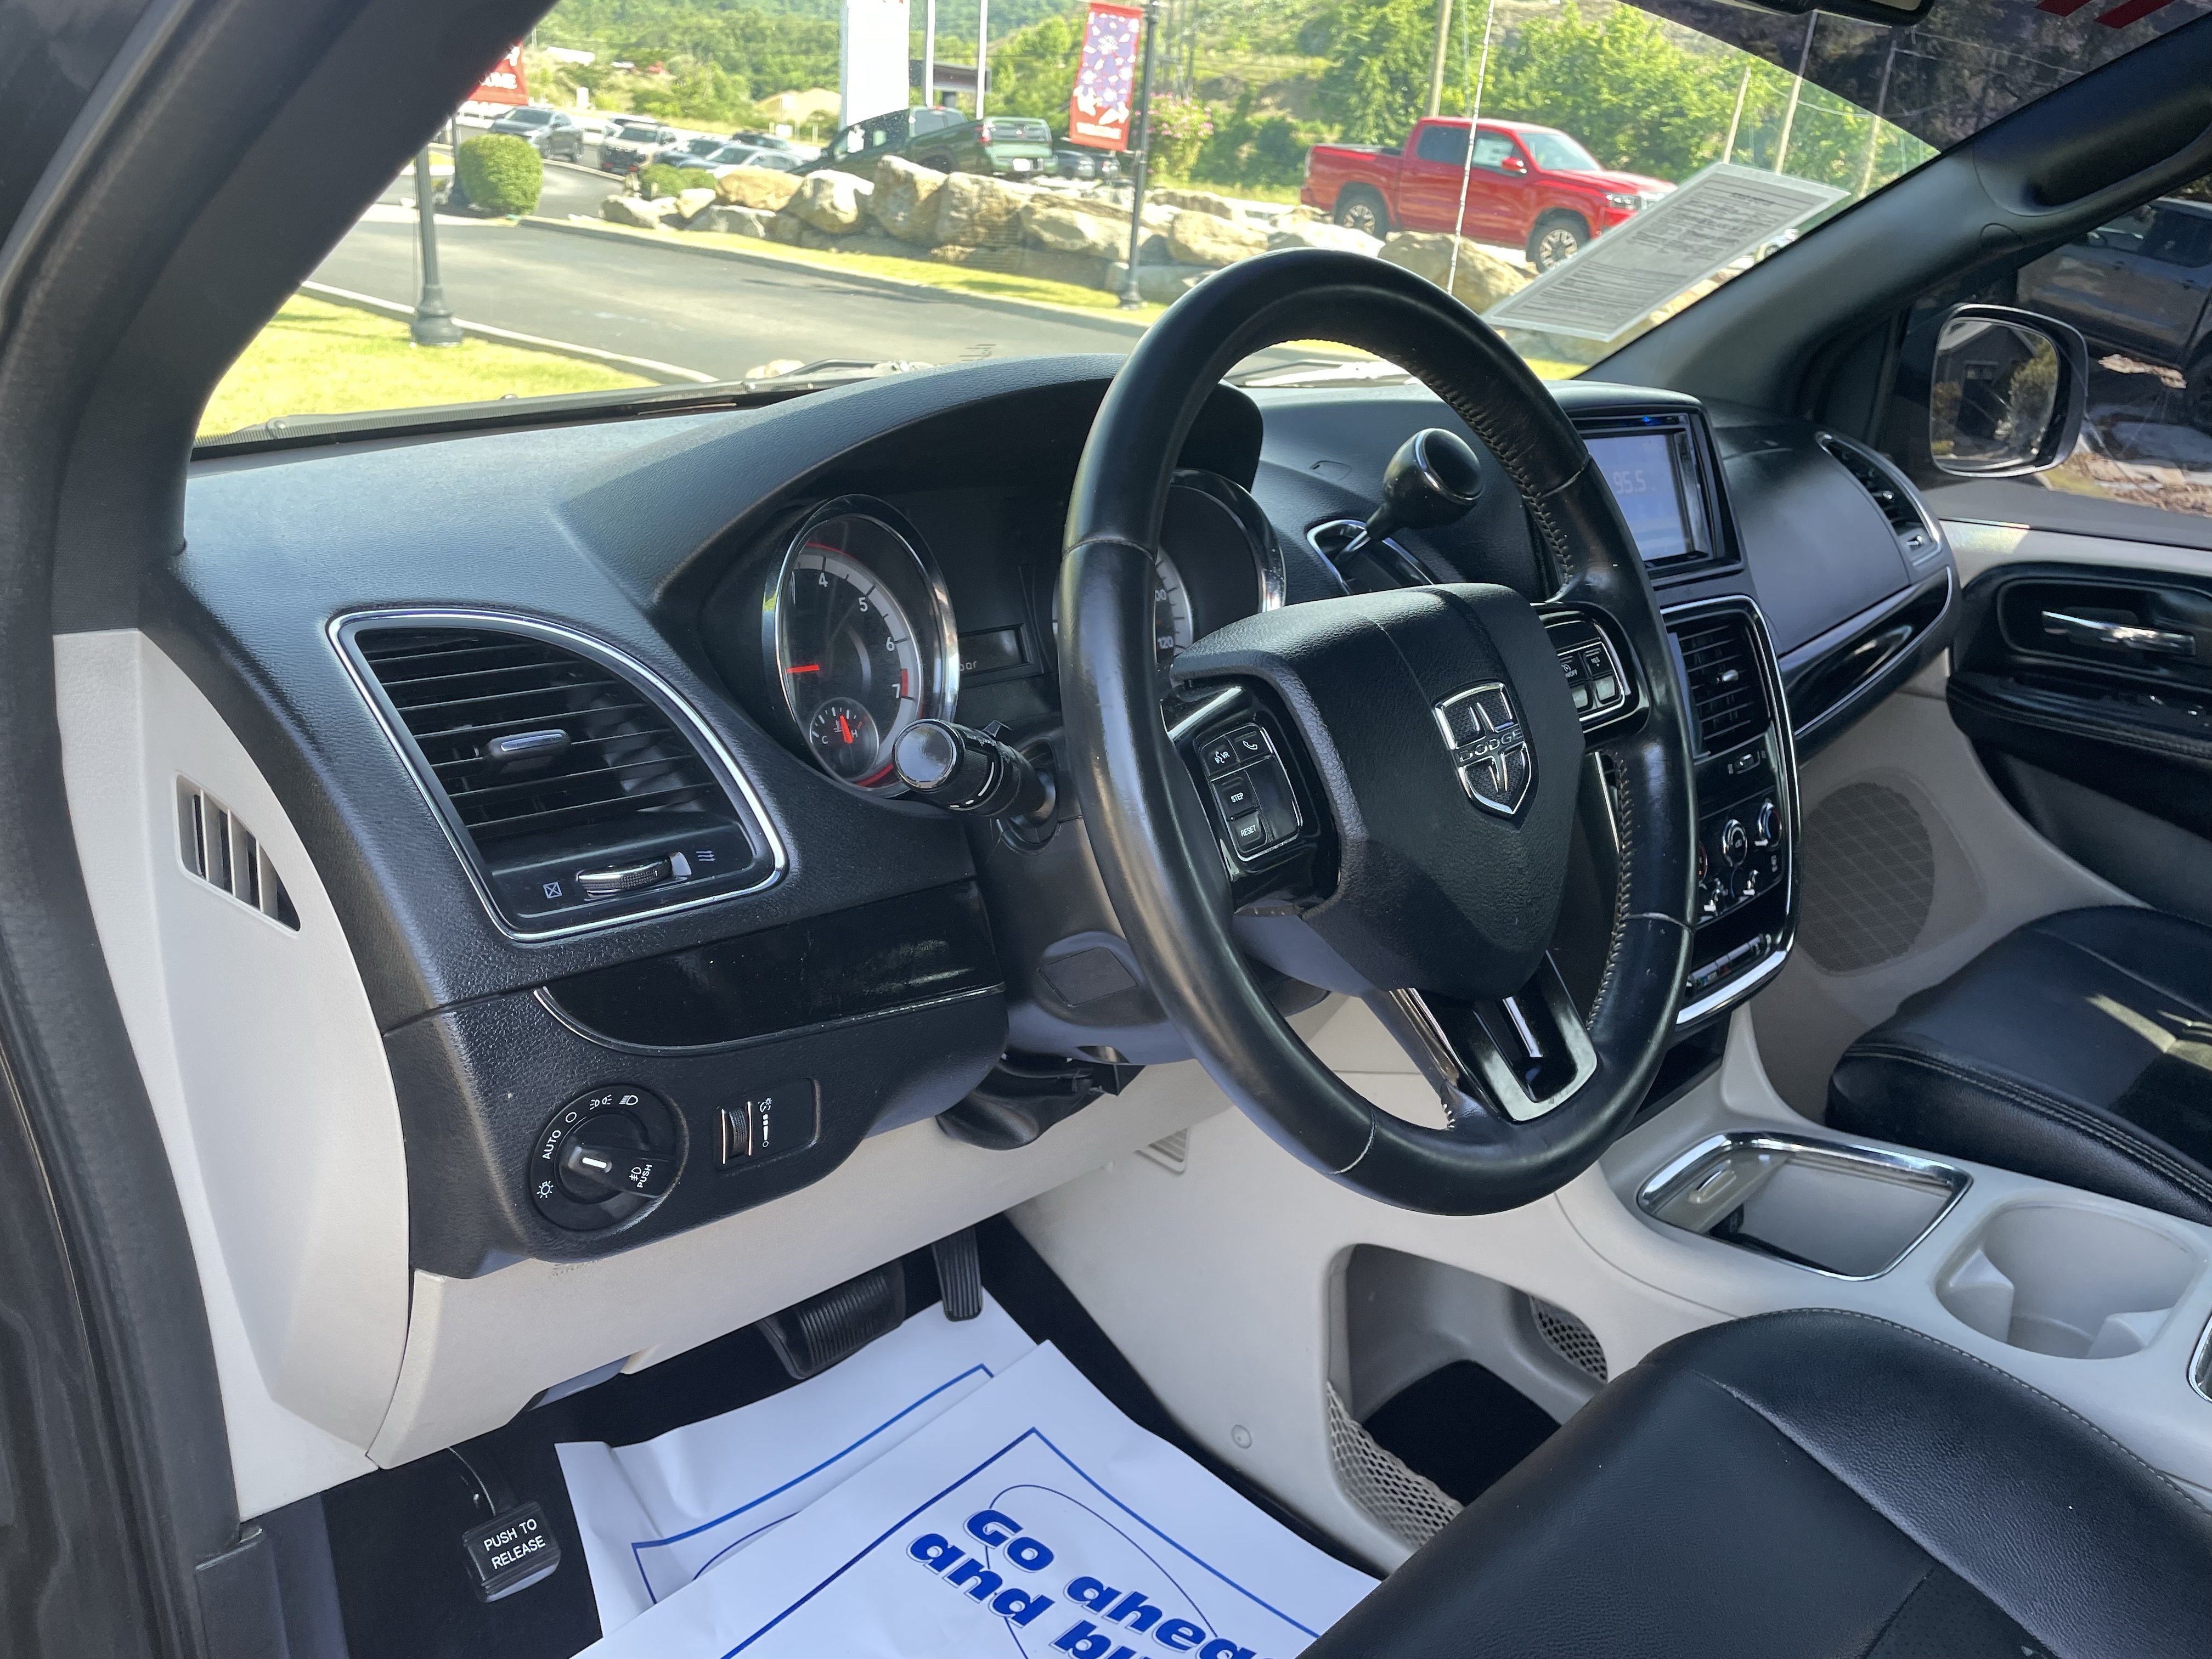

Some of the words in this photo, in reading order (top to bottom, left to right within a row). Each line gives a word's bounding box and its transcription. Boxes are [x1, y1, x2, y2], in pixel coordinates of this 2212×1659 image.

[1613, 470, 1646, 494] 95.5
[819, 572, 828, 588] 4
[1155, 589, 1167, 602] 00
[859, 597, 868, 612] 5
[886, 637, 895, 651] 6
[1158, 636, 1174, 650] 120
[892, 684, 900, 698] 7
[822, 736, 828, 745] C
[851, 729, 858, 738] H
[1458, 729, 1523, 763] DODGE
[1221, 751, 1231, 760] VR
[1231, 792, 1244, 803] STEP
[1240, 825, 1257, 837] RESET
[542, 1129, 562, 1160] AUTO
[636, 1164, 653, 1189] PUSH
[483, 1527, 518, 1551] PUSH
[518, 1519, 537, 1534] TO
[491, 1535, 546, 1570] RELEASE
[906, 1532, 1056, 1629] and
[963, 1509, 1055, 1573] Go
[1063, 1576, 1265, 1659] ahea
